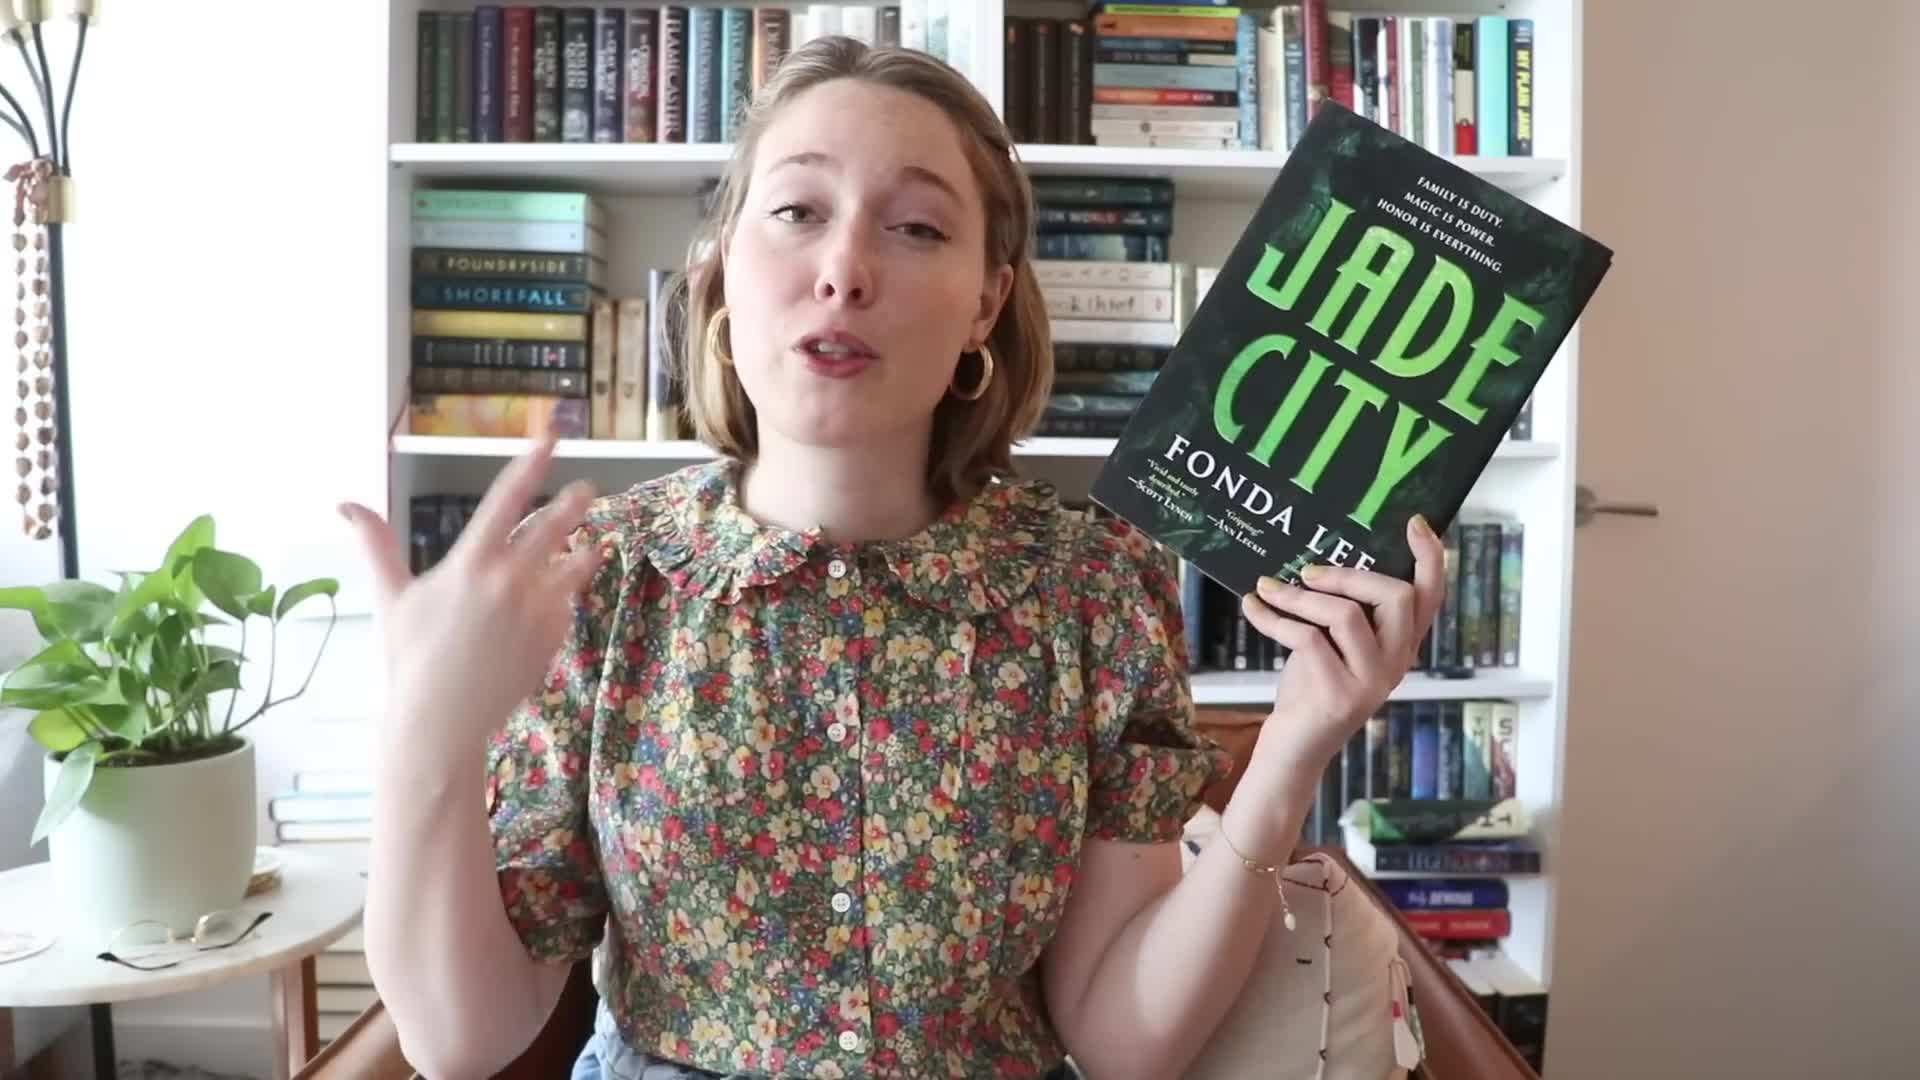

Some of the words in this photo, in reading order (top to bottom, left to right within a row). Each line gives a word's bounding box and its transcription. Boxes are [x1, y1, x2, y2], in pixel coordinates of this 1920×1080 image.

[1516, 49, 1531, 68] MY
[1403, 192, 1442, 217] MAGIC
[1441, 212, 1456, 224] IS
[1417, 176, 1458, 203] FAMILY
[1457, 198, 1472, 211] IS
[1470, 204, 1503, 229] DUTY.
[1377, 198, 1419, 227] HONOR
[1419, 221, 1434, 233] IS
[1432, 228, 1503, 273] EVERYTHING.
[447, 256, 567, 274] FOUNDRYSIDE
[444, 287, 566, 306] SHOREFALL
[1246, 198, 1545, 425] JADE
[1213, 334, 1454, 531] CITY
[1164, 433, 1293, 536] FONDA
